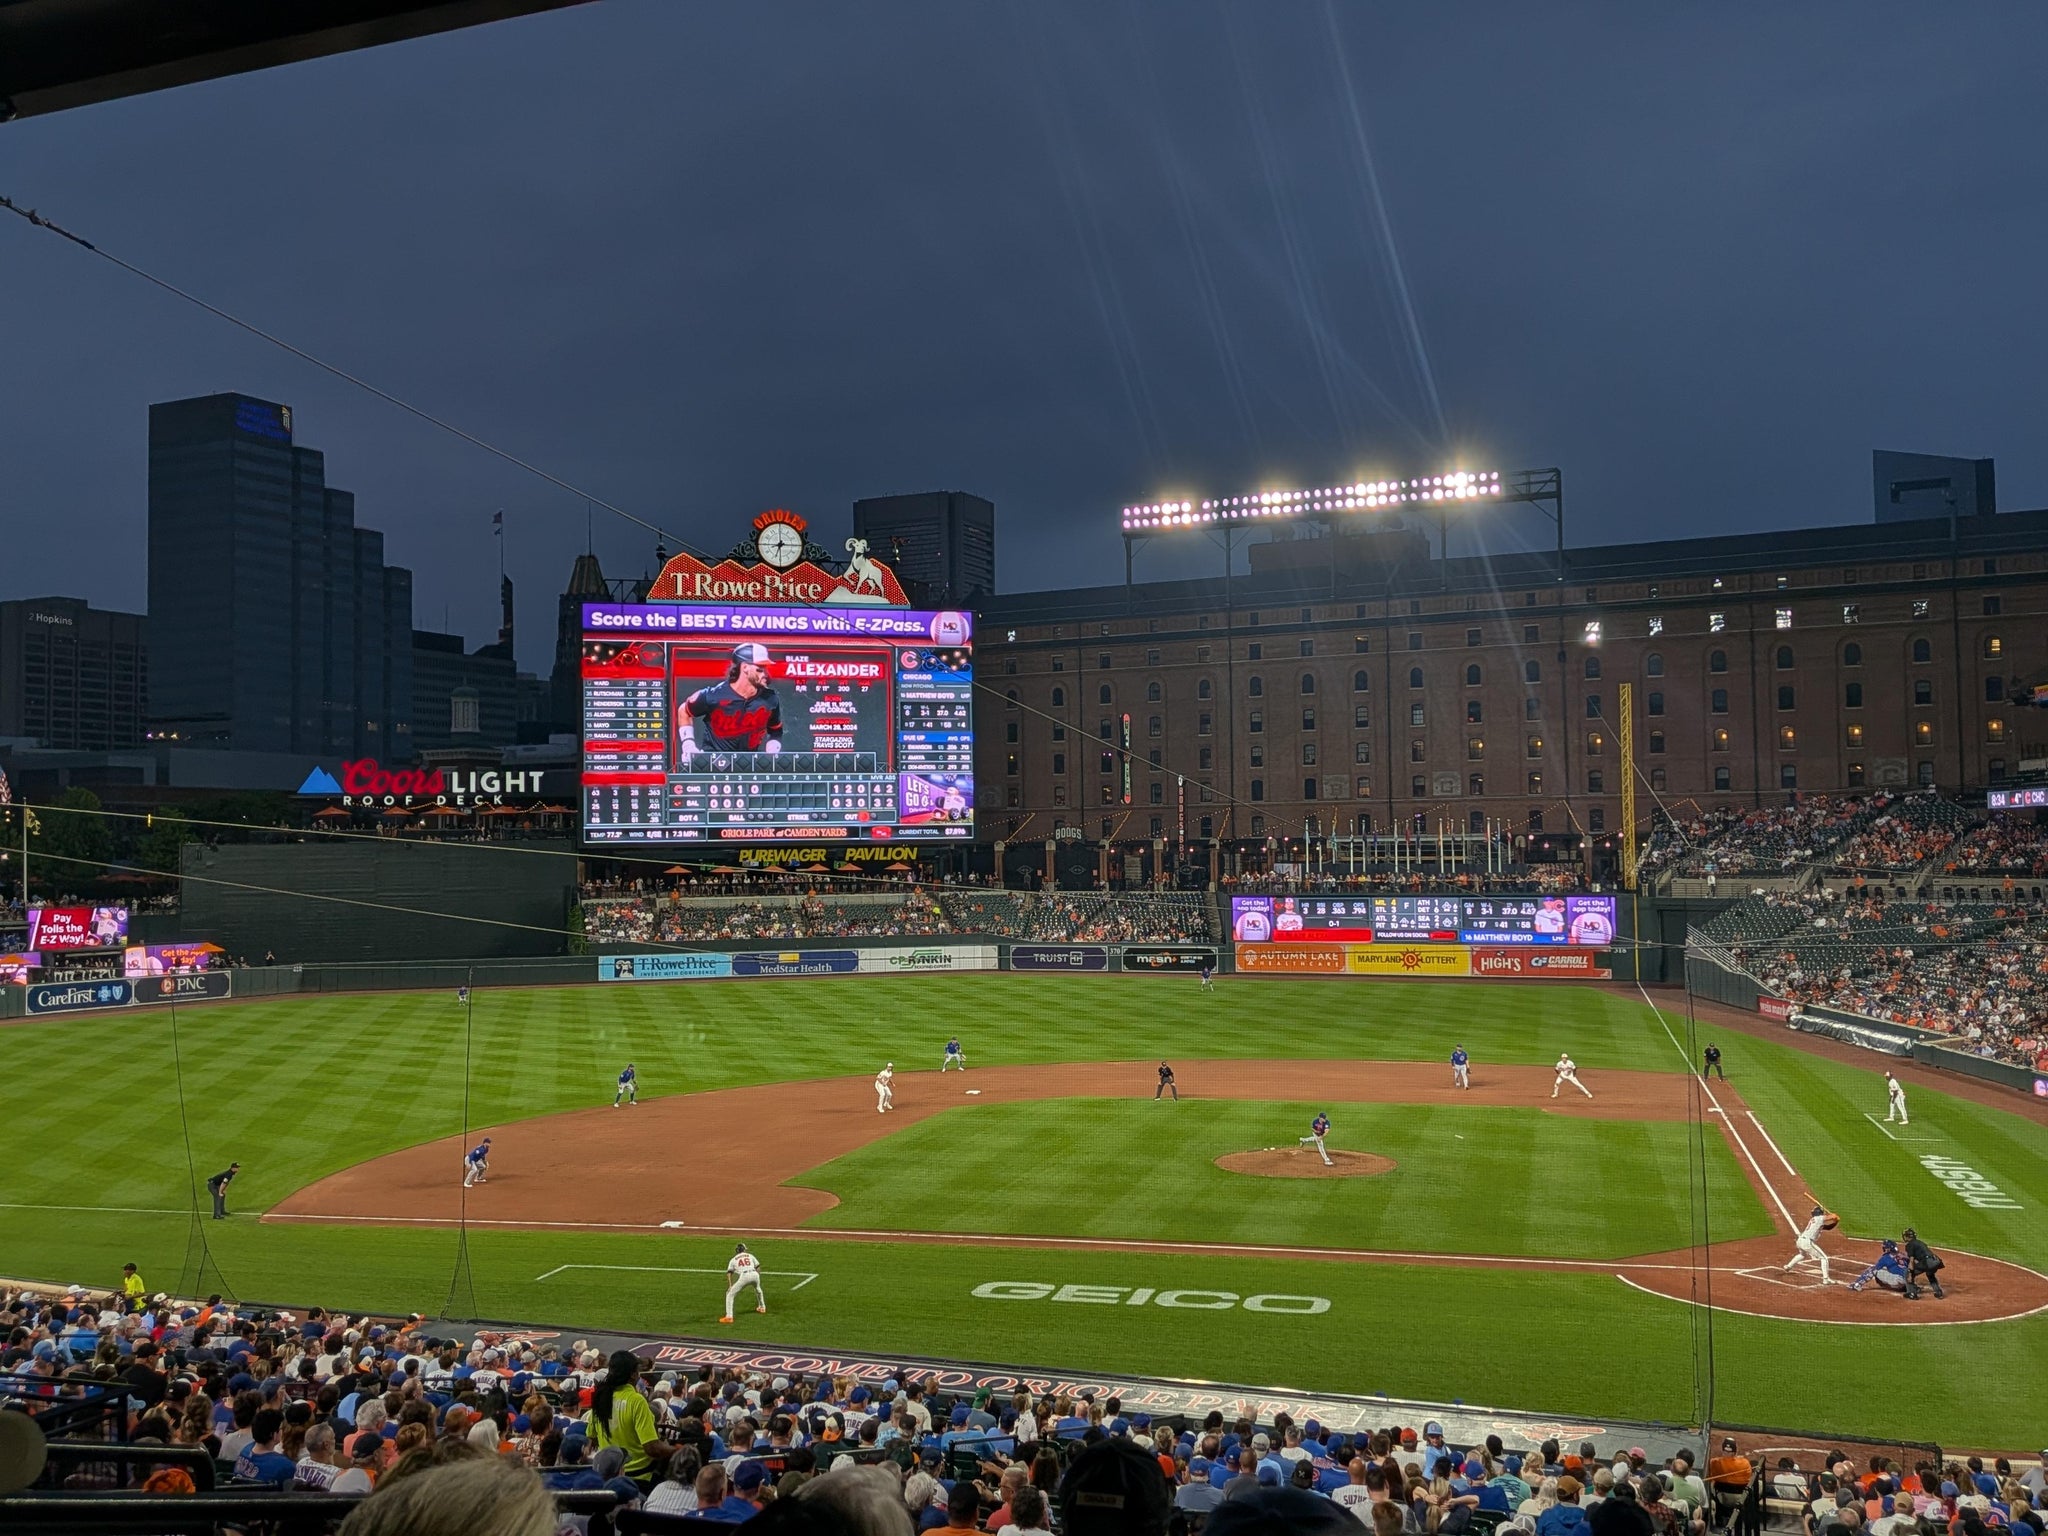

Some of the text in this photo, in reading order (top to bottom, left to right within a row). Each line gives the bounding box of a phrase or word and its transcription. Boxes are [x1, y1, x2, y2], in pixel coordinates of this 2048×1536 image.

[753, 508, 808, 532] ORIOLES
[694, 573, 761, 599] Rowe
[764, 575, 822, 600] Price
[36, 613, 72, 626] Hopkins
[592, 612, 642, 626] Score
[646, 613, 677, 627] the
[681, 614, 728, 628] BEST
[731, 615, 808, 630] SAVINGS
[812, 616, 850, 630] with
[786, 664, 880, 676] ALEXANDER
[342, 758, 544, 795] Coors LIGHT
[710, 785, 718, 794] 0
[723, 785, 731, 794] 0
[738, 785, 742, 794] 1
[751, 785, 759, 794] 0
[833, 785, 839, 793] 1
[845, 785, 852, 793] 2
[858, 785, 865, 793] 0
[874, 785, 881, 793] 4
[886, 785, 893, 793] 2
[343, 795, 503, 806] ROOF DECK
[710, 799, 718, 808] 0
[723, 799, 731, 808] 0
[736, 799, 744, 808] 0
[833, 799, 840, 807] 0
[845, 799, 852, 807] 3
[858, 799, 865, 807] 0
[874, 799, 881, 807] 3
[886, 799, 893, 807] 2
[754, 829, 775, 837] PARK
[785, 829, 820, 837] CAMDEN
[821, 828, 847, 836] YARDS
[1056, 827, 1082, 840] BOOGS
[739, 847, 918, 862] PUREWAGER PAVILION
[53, 914, 72, 924] Pay
[41, 925, 64, 933] Tolls
[40, 934, 84, 944] E-Z Way!
[652, 957, 682, 970] Rowe
[687, 956, 716, 969] Price
[1034, 953, 1067, 962] TRUIST
[1549, 956, 1588, 964] CARROLL
[760, 963, 832, 973] MedStar Health
[1481, 958, 1521, 971] HIGH'S
[177, 977, 205, 990] PNC
[738, 1258, 751, 1267] 46
[970, 1281, 1332, 1314] GEICO
[655, 1346, 1338, 1422] WELCOME TO ORIOLE PARK
